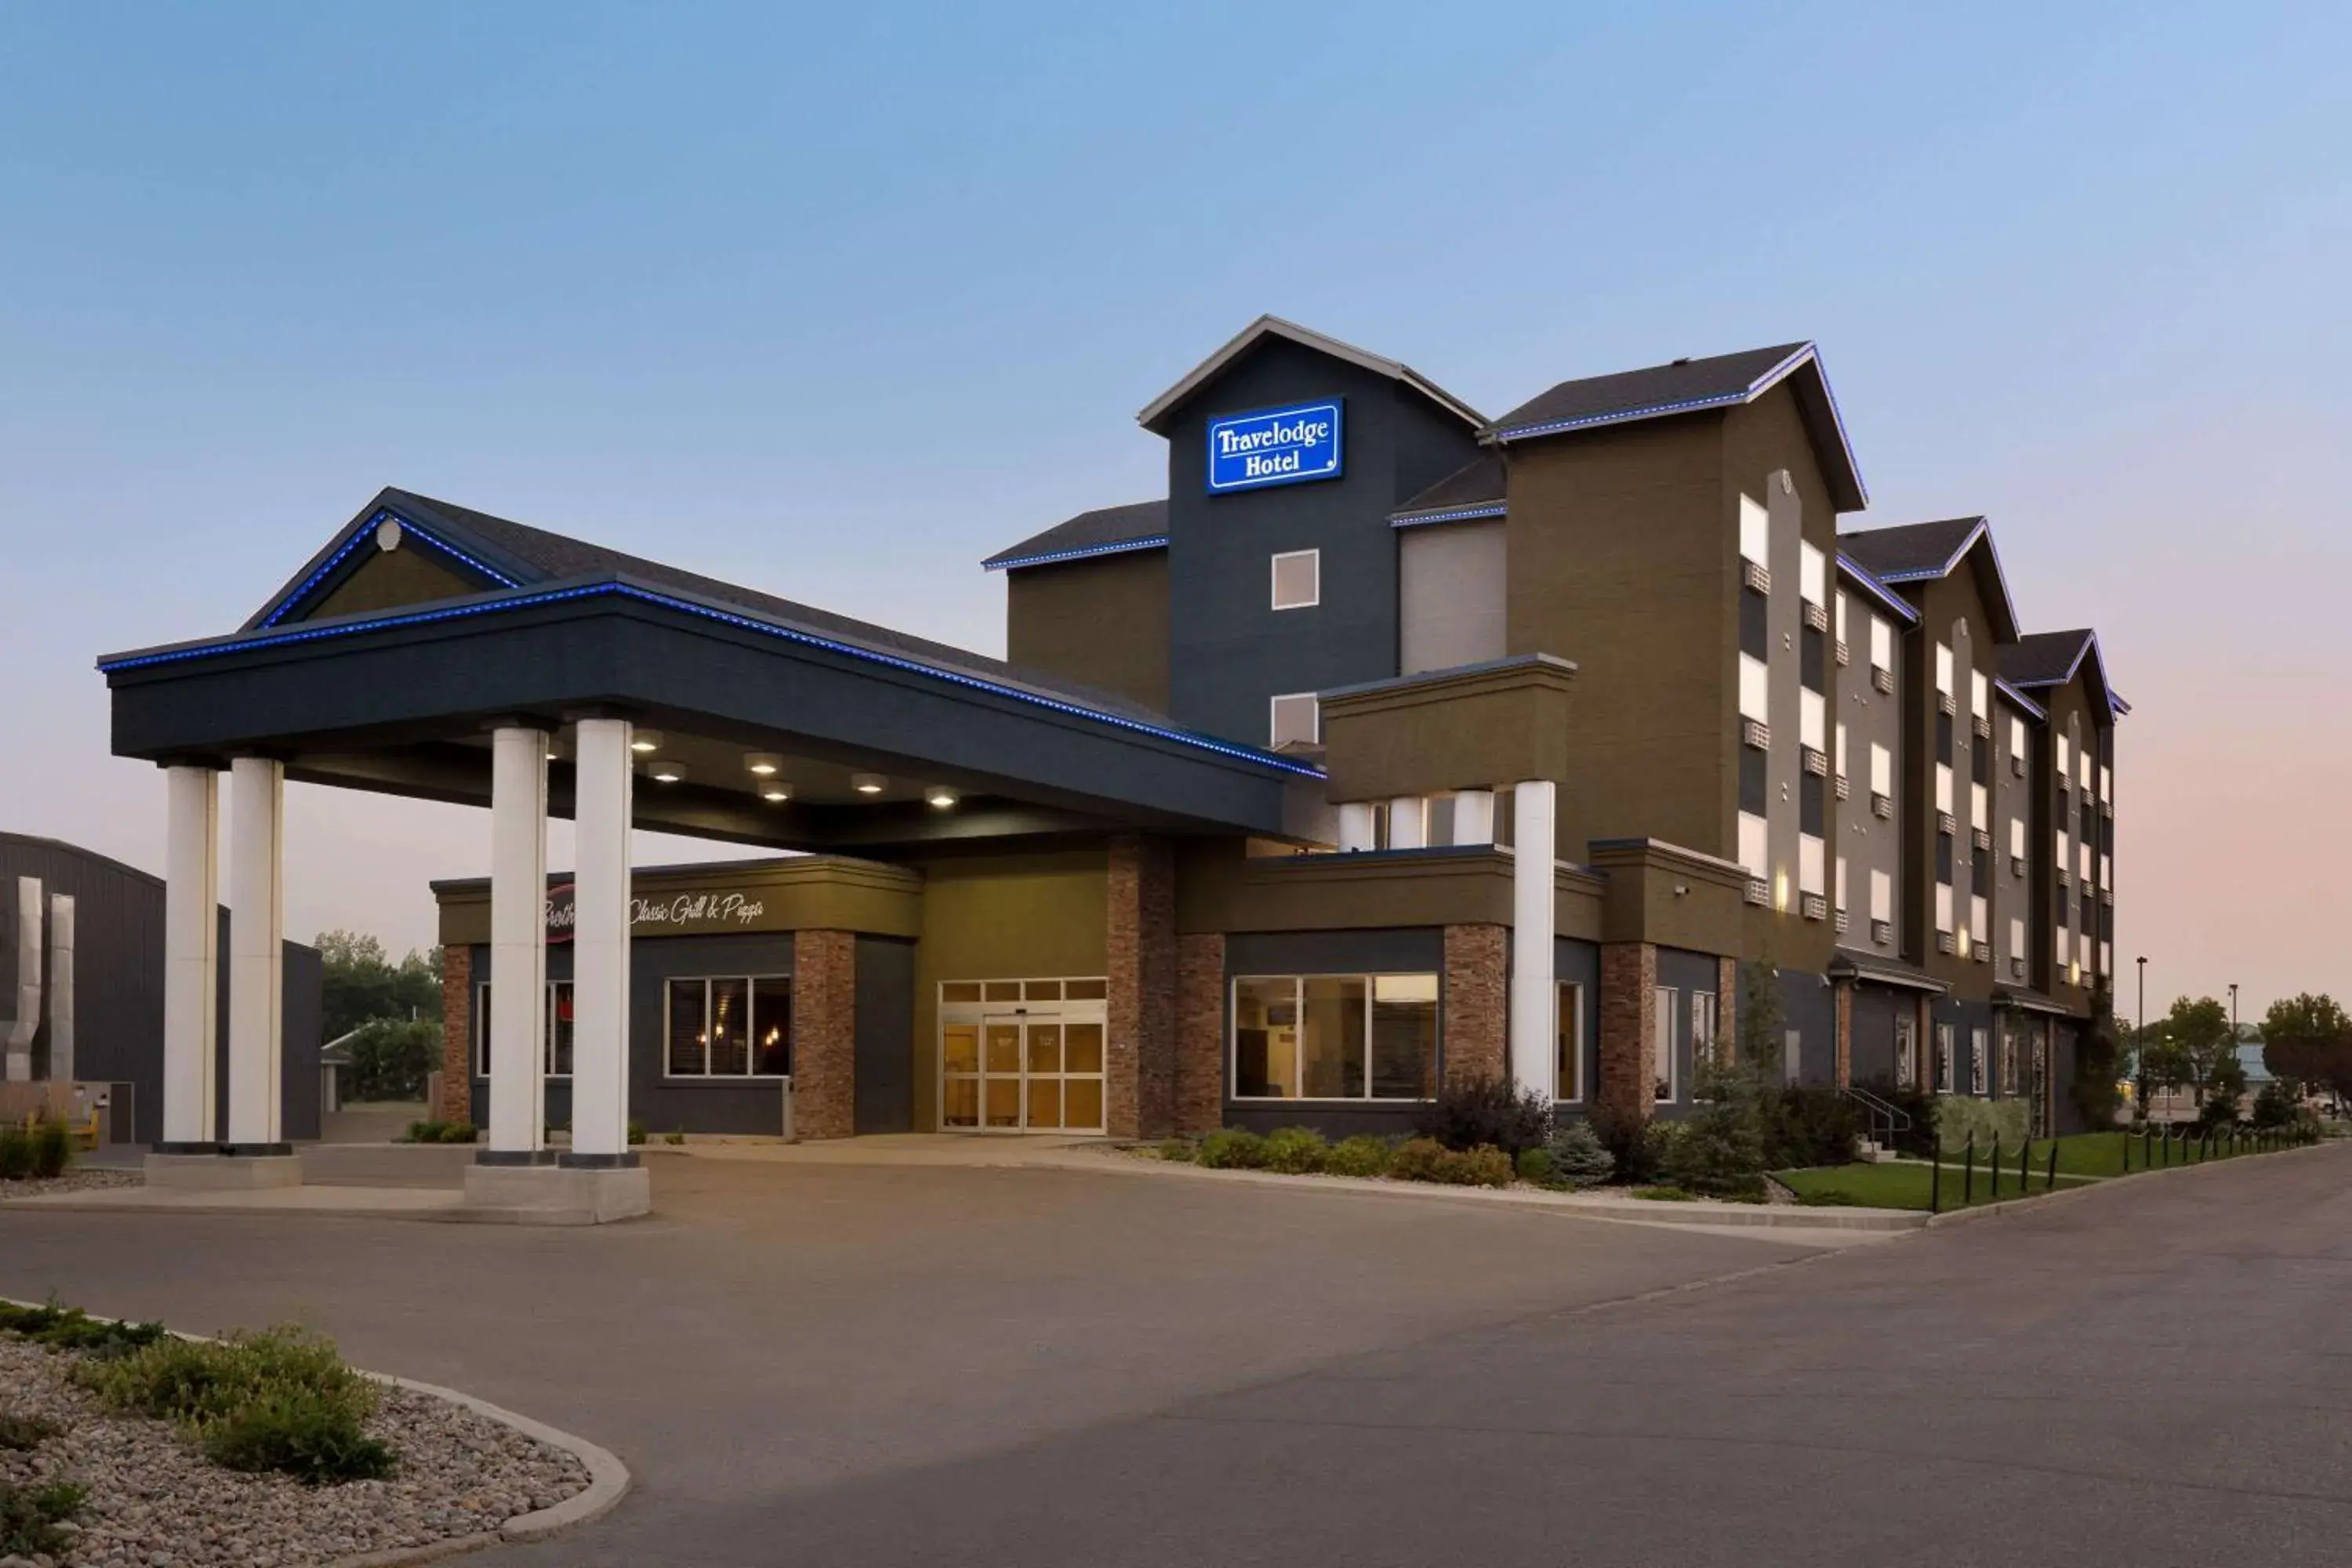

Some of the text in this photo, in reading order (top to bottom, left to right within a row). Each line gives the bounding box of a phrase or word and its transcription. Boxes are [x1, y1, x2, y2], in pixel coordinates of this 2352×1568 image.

[1218, 420, 1328, 453] Travelodge
[1246, 450, 1299, 477] Hotel
[629, 893, 764, 925] Classic Grill & Pizza
